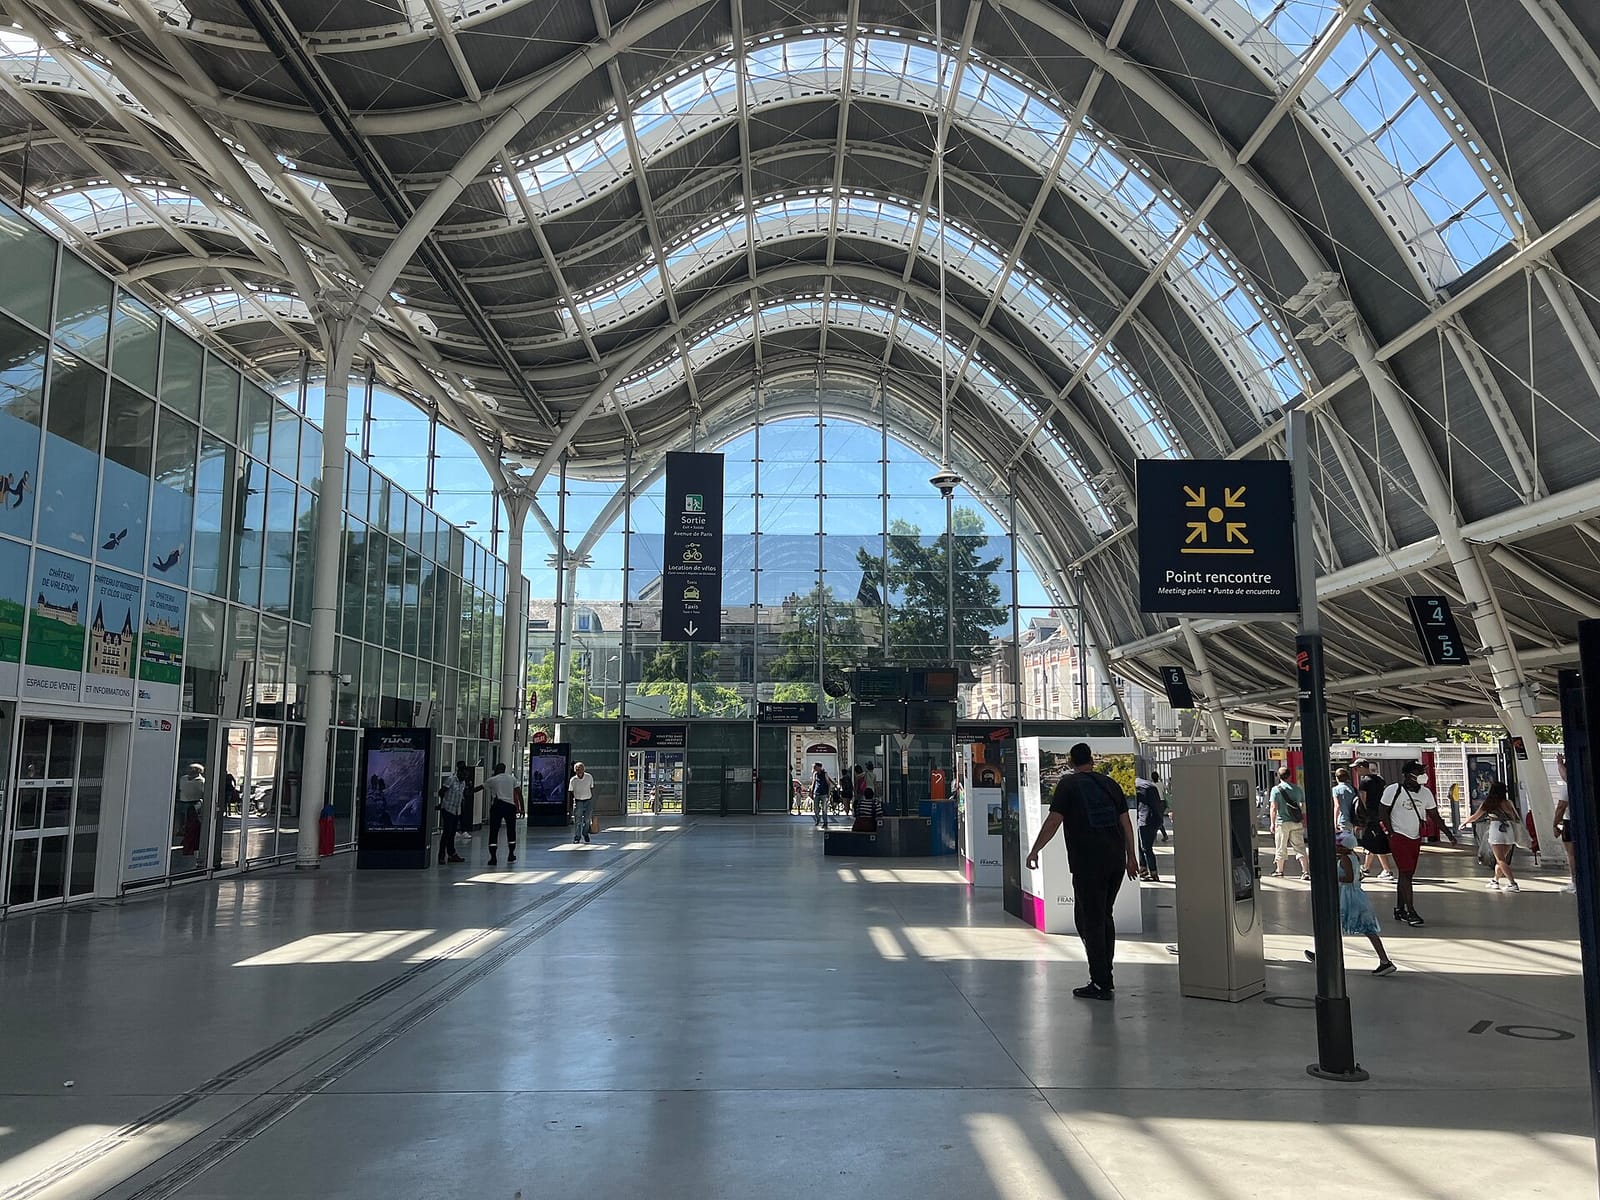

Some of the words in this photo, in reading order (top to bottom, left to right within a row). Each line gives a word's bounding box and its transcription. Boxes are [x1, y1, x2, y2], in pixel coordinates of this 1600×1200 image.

[681, 516, 706, 524] Sortie
[42, 578, 51, 587] DE
[1166, 570, 1202, 583] Point
[1205, 572, 1272, 584] rencontre
[1157, 587, 1186, 596] Meeting
[1187, 587, 1206, 596] point
[1213, 587, 1234, 595] Punto
[1432, 606, 1444, 621] 4
[1442, 641, 1453, 656] 5
[1172, 672, 1179, 682] 6
[26, 678, 49, 689] ESPACE
[49, 681, 58, 690] DE
[58, 682, 77, 692] VENTE
[85, 685, 92, 693] ET
[92, 686, 131, 697] INFORMATIONS
[1351, 720, 1356, 733] 6
